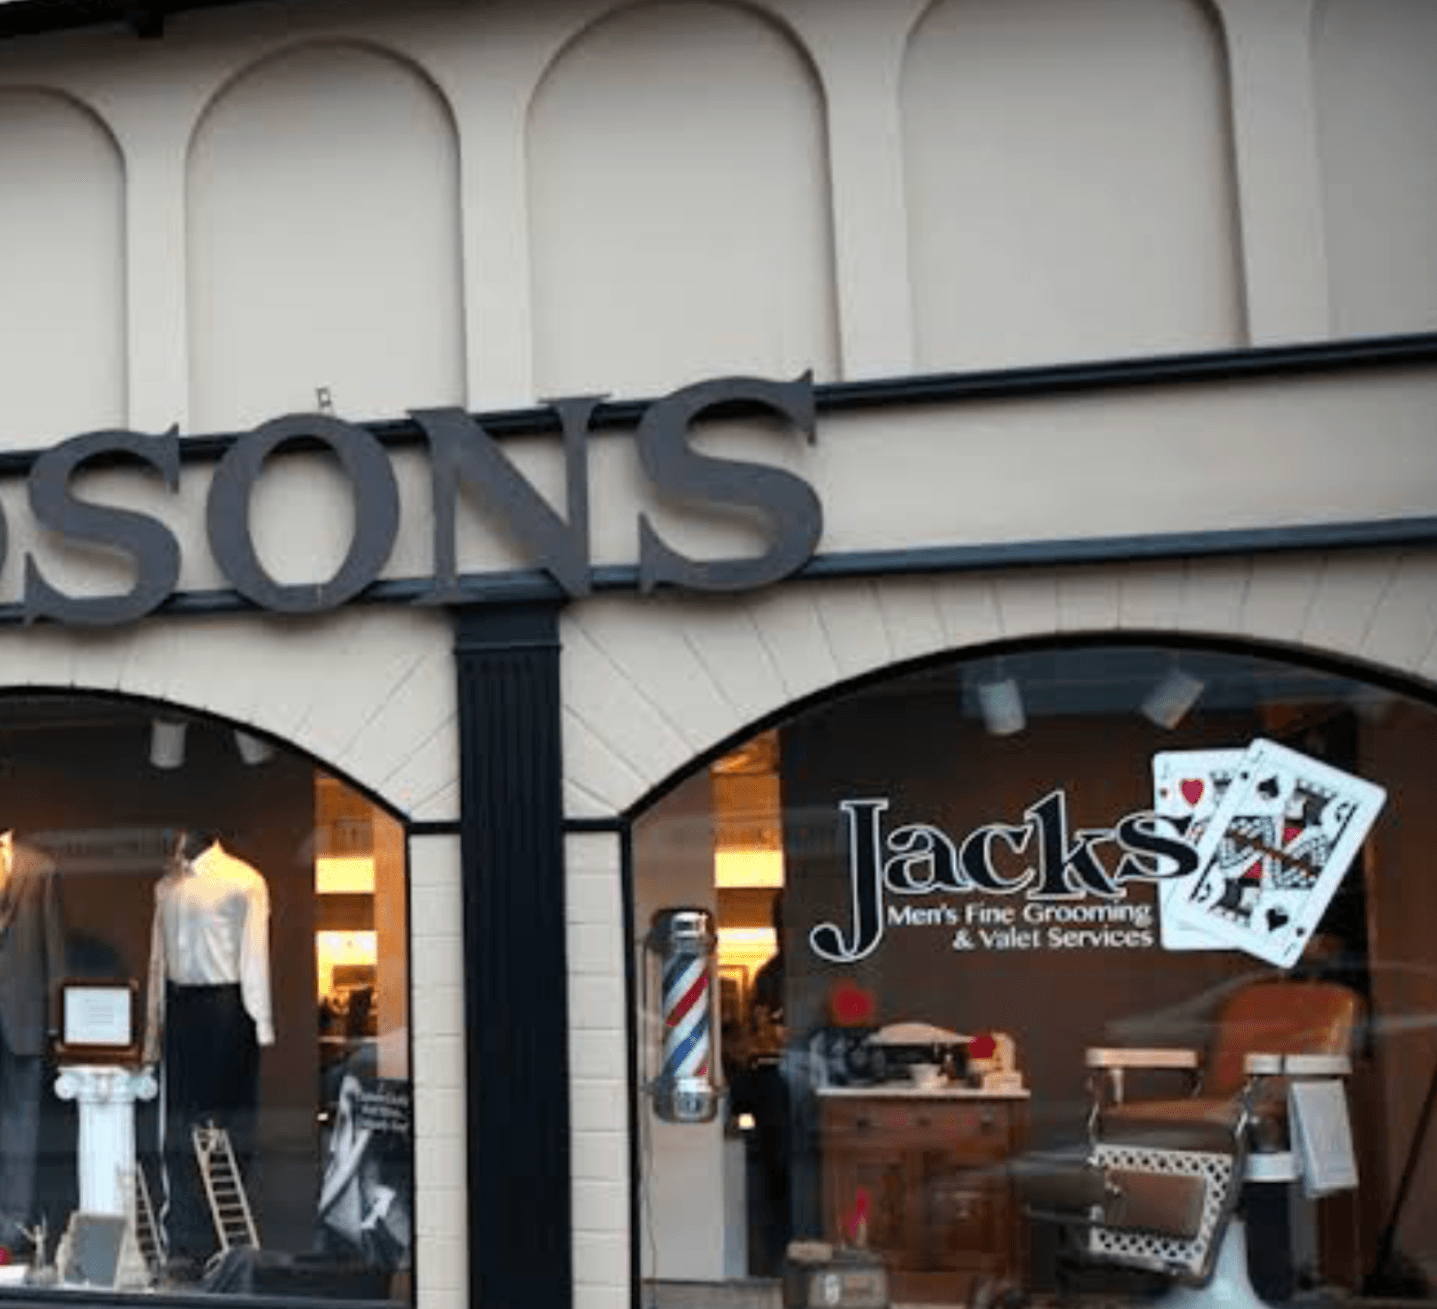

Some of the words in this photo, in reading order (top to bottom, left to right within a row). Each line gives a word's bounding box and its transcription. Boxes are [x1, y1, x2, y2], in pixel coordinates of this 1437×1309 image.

[810, 790, 1199, 962] Jacks
[887, 904, 958, 926] Men's
[965, 903, 1016, 924] Fine
[1023, 902, 1153, 927] Grooming
[952, 931, 975, 950] &
[979, 927, 1041, 949] Valet
[1048, 927, 1154, 949] Services
